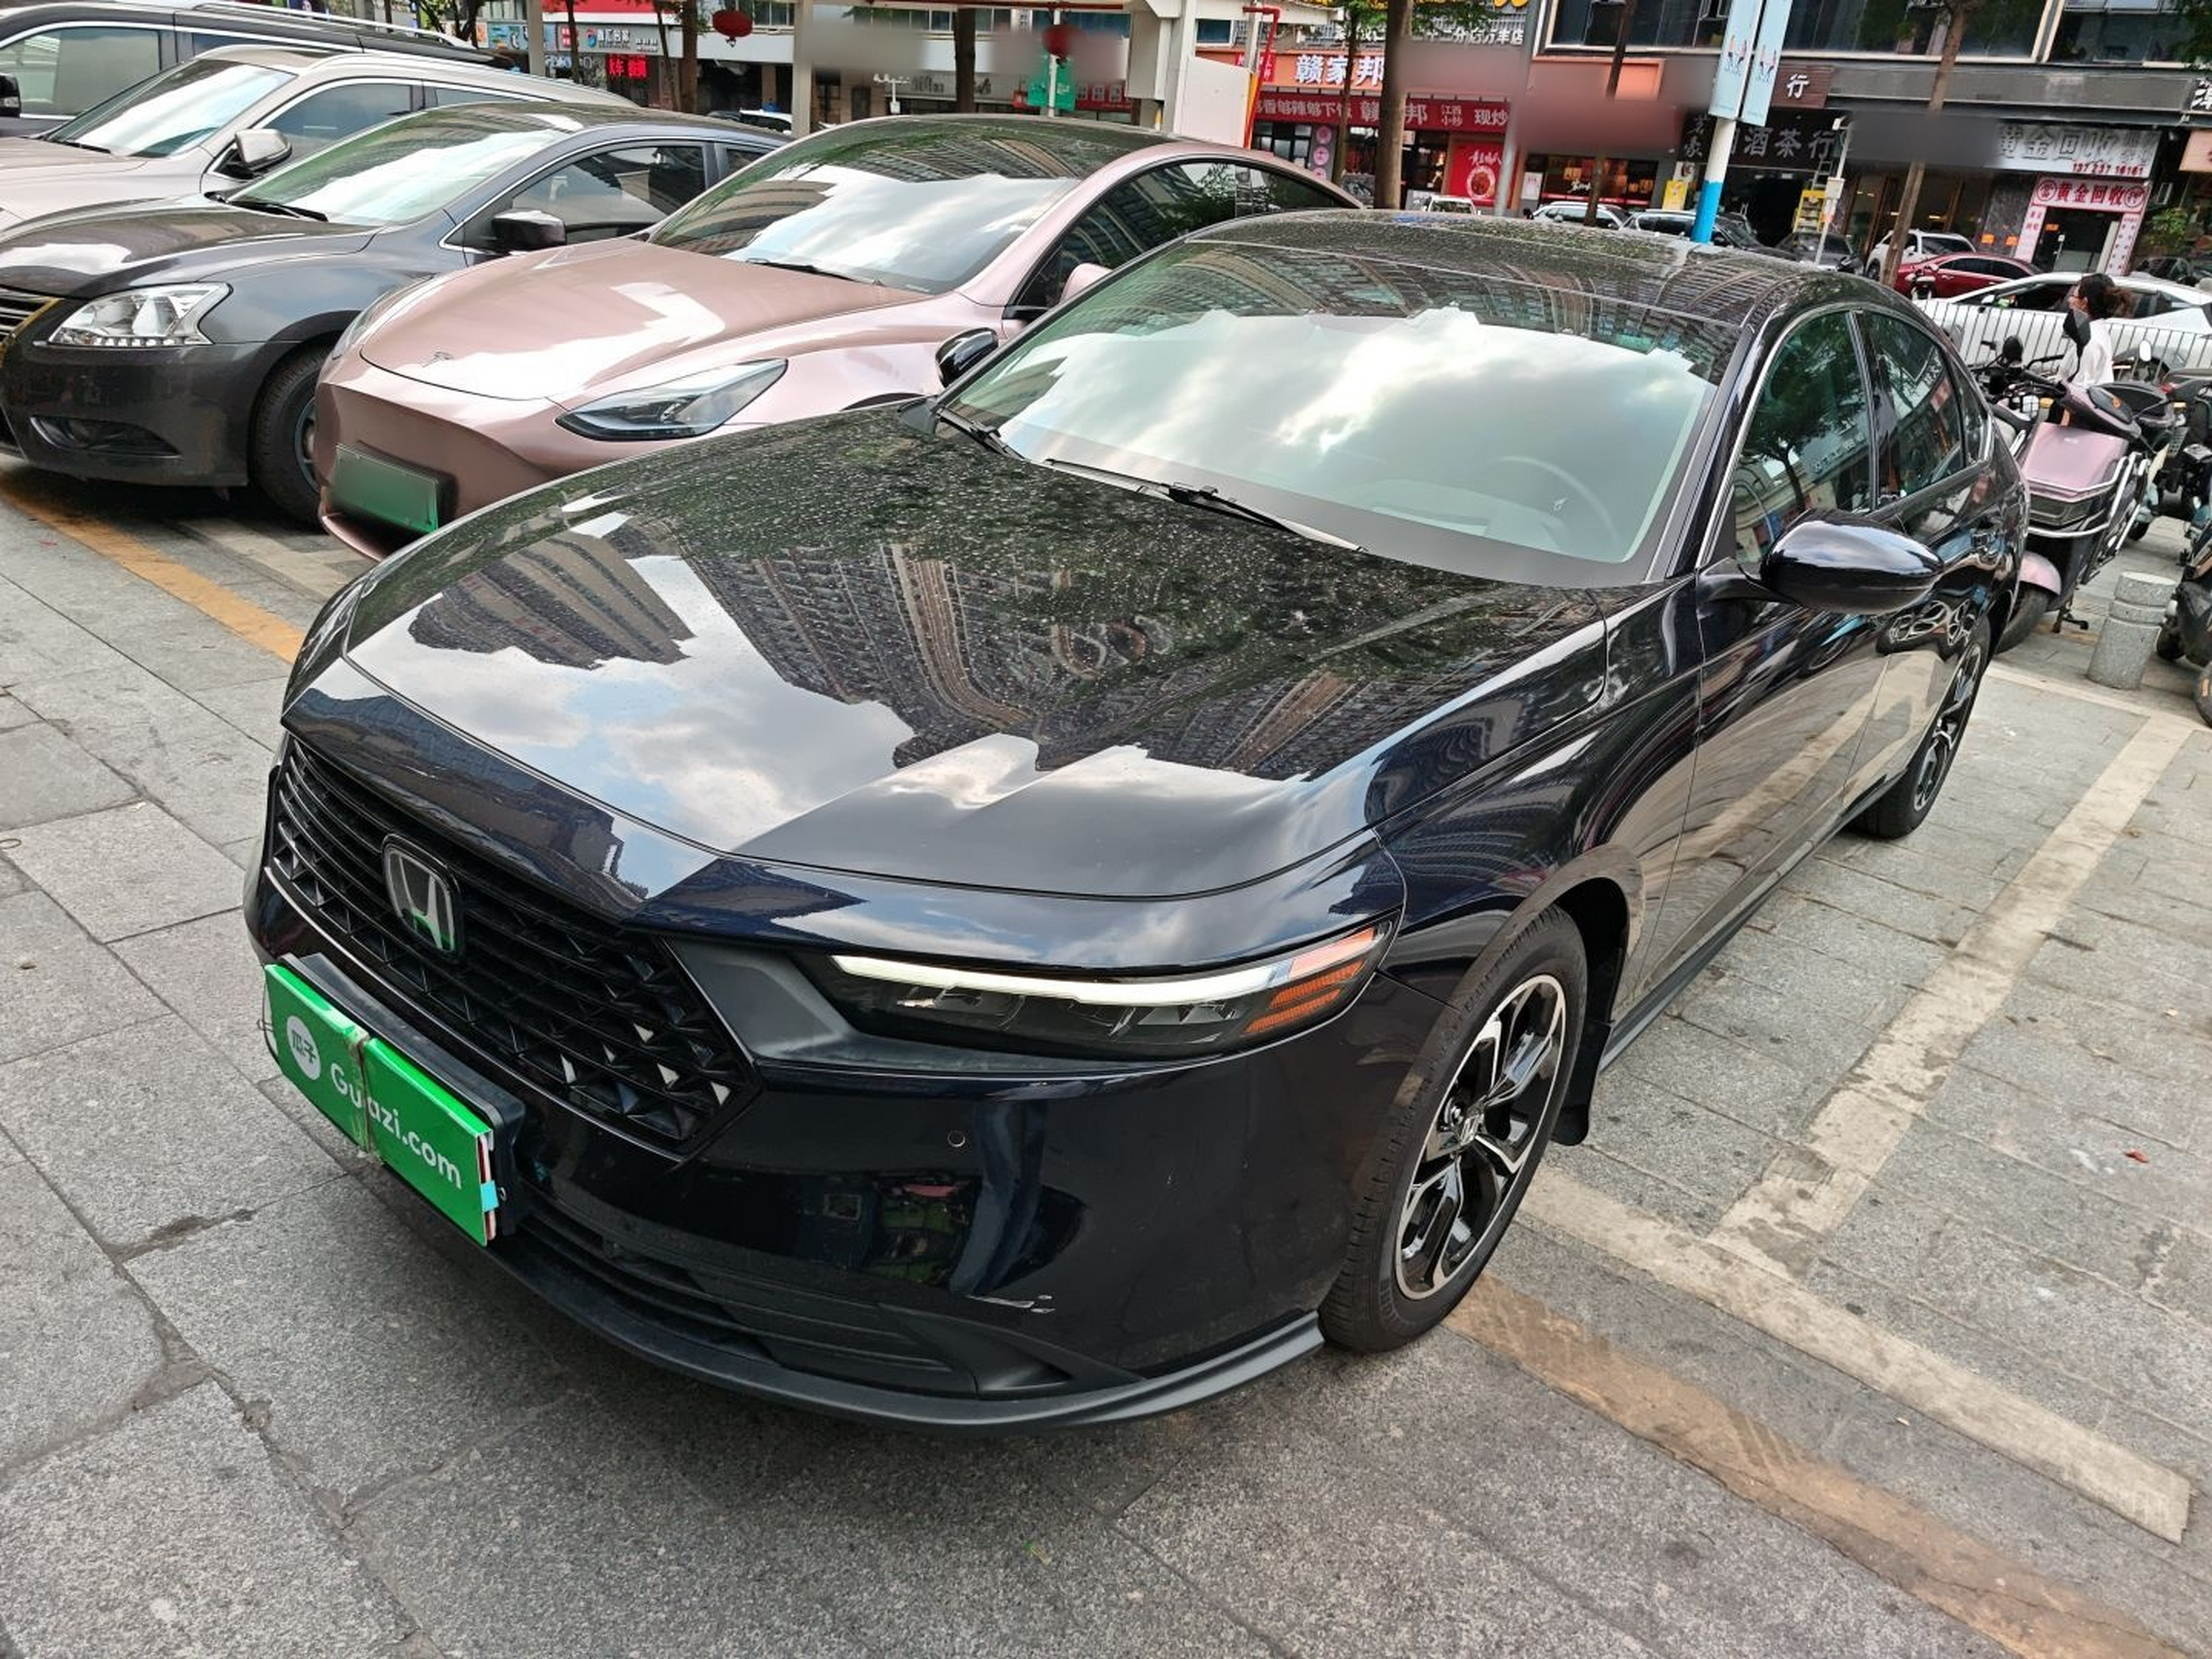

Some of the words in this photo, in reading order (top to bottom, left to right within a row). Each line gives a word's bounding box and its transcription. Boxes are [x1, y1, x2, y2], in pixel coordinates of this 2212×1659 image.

[1787, 73, 1809, 99] 行
[1474, 108, 1508, 126] 现炒
[1730, 127, 1835, 159] 酒茶行
[330, 1063, 461, 1189] Guazi.com
